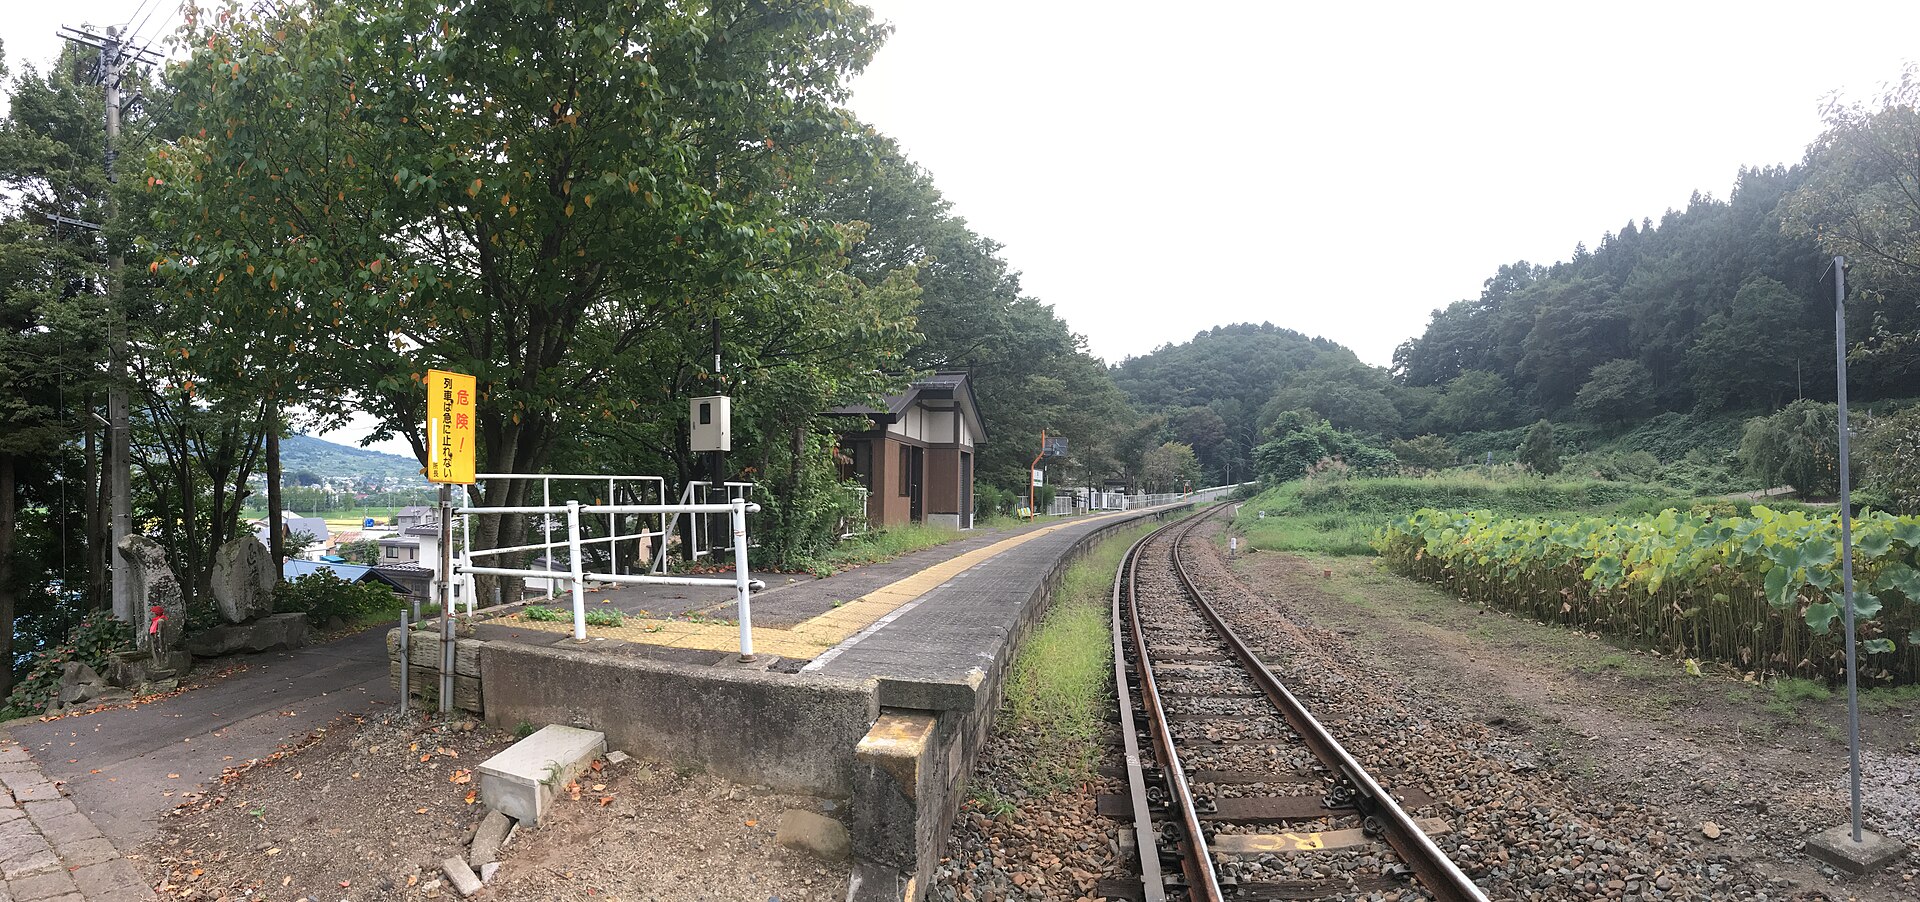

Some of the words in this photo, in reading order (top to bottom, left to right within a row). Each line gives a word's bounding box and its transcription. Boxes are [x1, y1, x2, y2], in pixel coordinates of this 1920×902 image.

[442, 378, 453, 478] 列車は急に止れない
